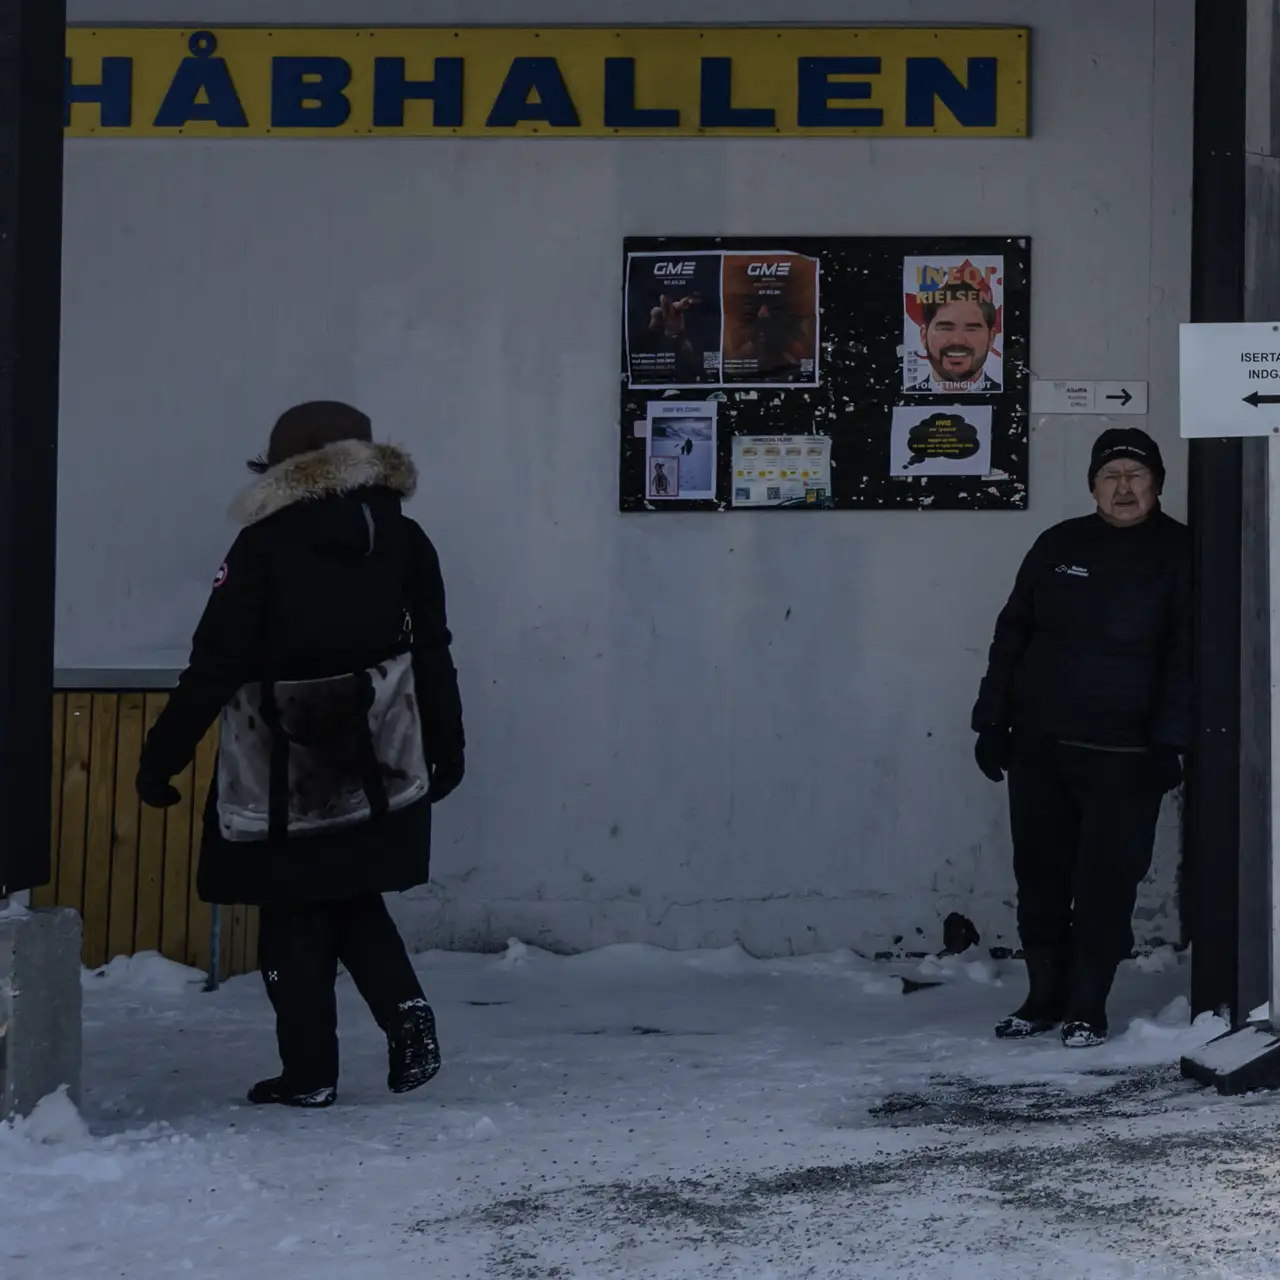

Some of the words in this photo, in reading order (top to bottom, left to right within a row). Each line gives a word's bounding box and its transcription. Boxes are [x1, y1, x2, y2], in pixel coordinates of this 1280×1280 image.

[64, 31, 998, 128] HÅBHALLEN
[653, 261, 696, 275] GME
[747, 262, 791, 276] GME
[916, 291, 992, 304] NIELSEN
